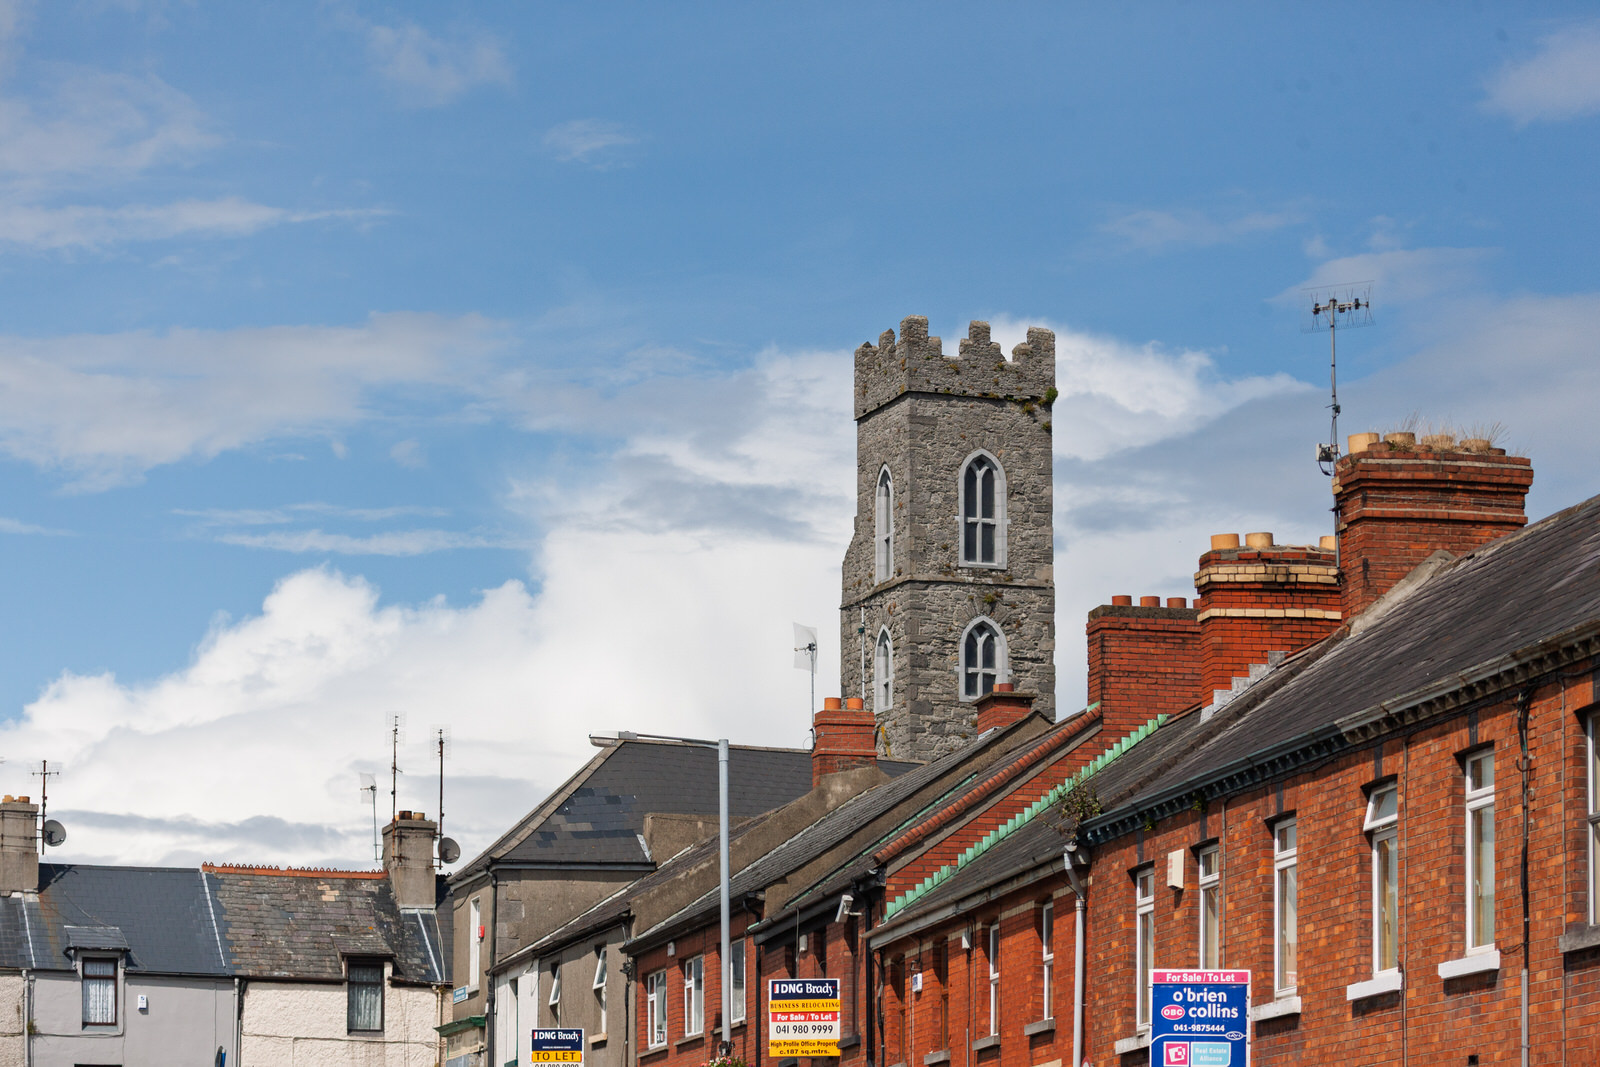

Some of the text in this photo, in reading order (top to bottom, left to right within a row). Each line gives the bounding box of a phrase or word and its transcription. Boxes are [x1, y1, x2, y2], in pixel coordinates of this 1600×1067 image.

[1166, 974, 1235, 982] For Sale / To Let
[780, 982, 832, 996] DNG Brady
[1172, 988, 1227, 1002] o'brien
[1188, 1004, 1238, 1018] collins
[776, 1024, 834, 1034] 041 980 9999
[538, 1032, 578, 1042] DNG Brady
[534, 1052, 576, 1060] TO LET
